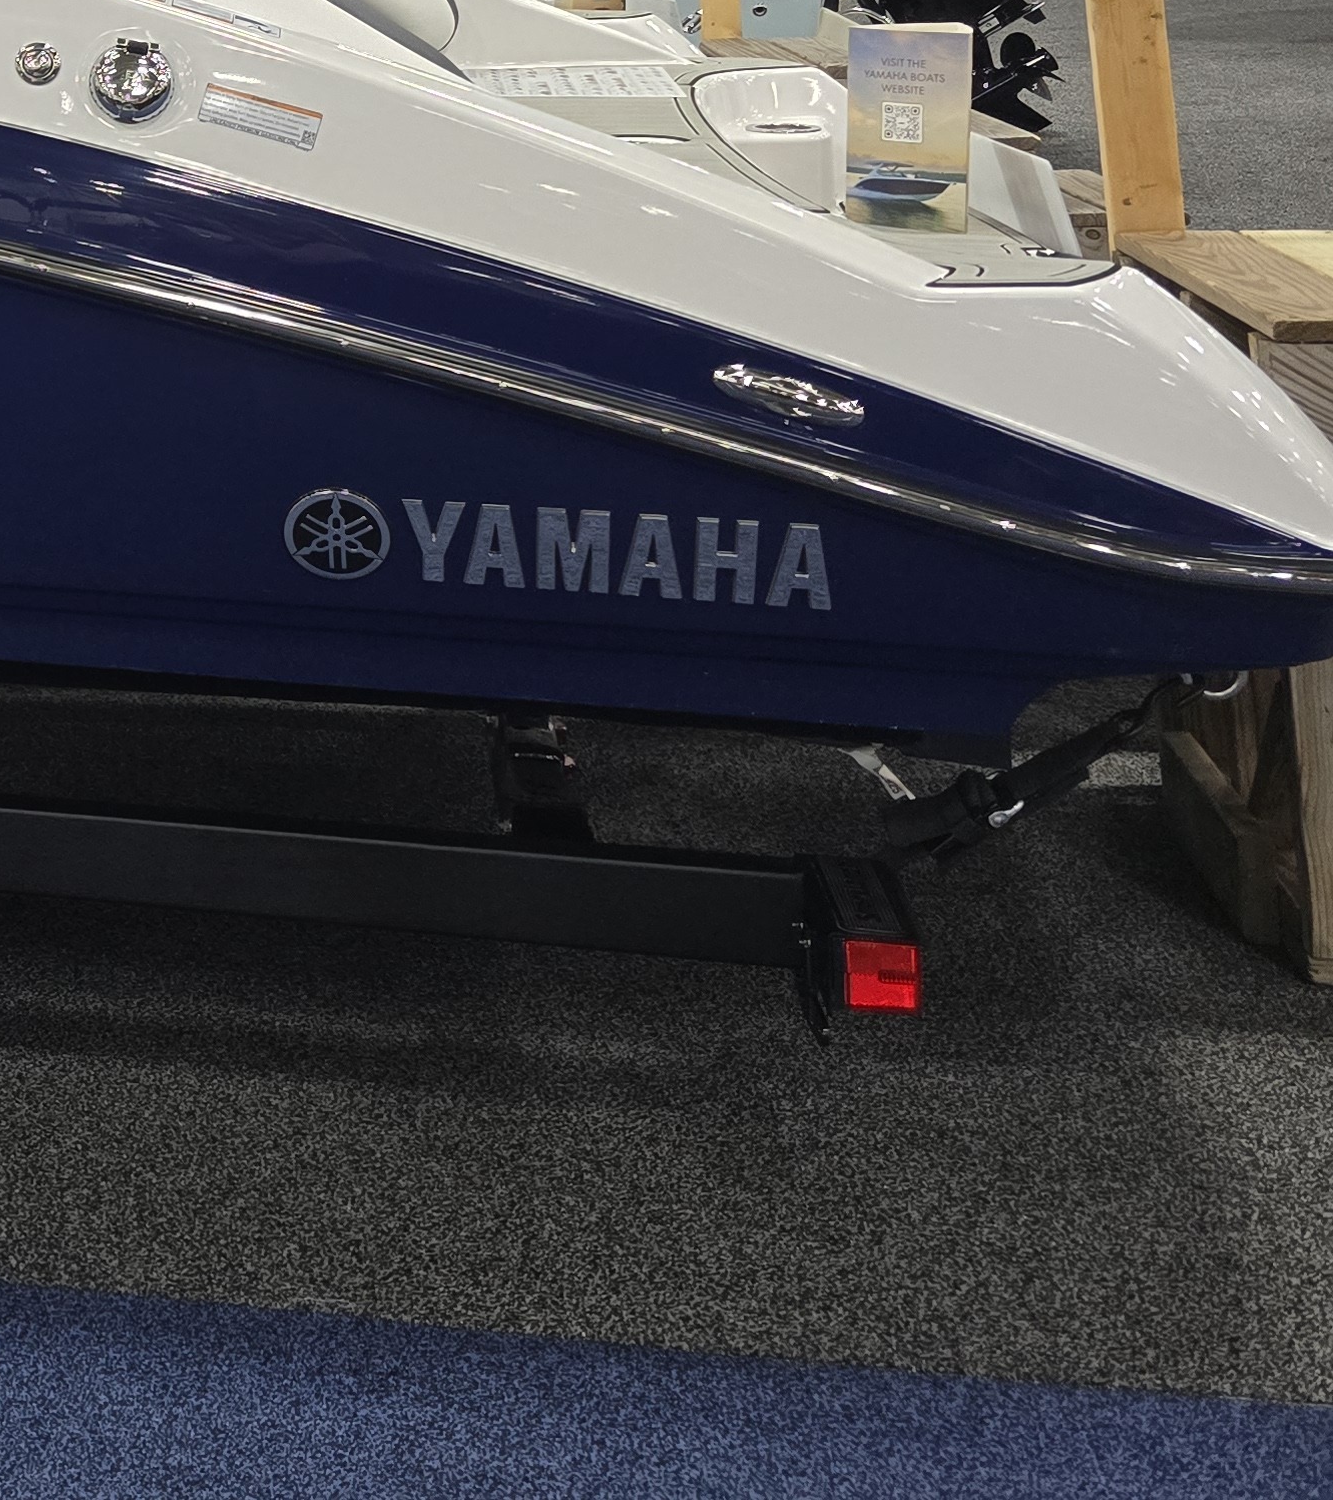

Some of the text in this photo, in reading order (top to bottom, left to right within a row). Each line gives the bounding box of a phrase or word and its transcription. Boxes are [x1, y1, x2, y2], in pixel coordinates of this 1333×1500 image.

[881, 57, 926, 69] VISIT THE
[864, 69, 946, 84] YAMAHA BOATS
[881, 84, 925, 96] WEBSITE
[402, 498, 832, 611] YAMAHA
